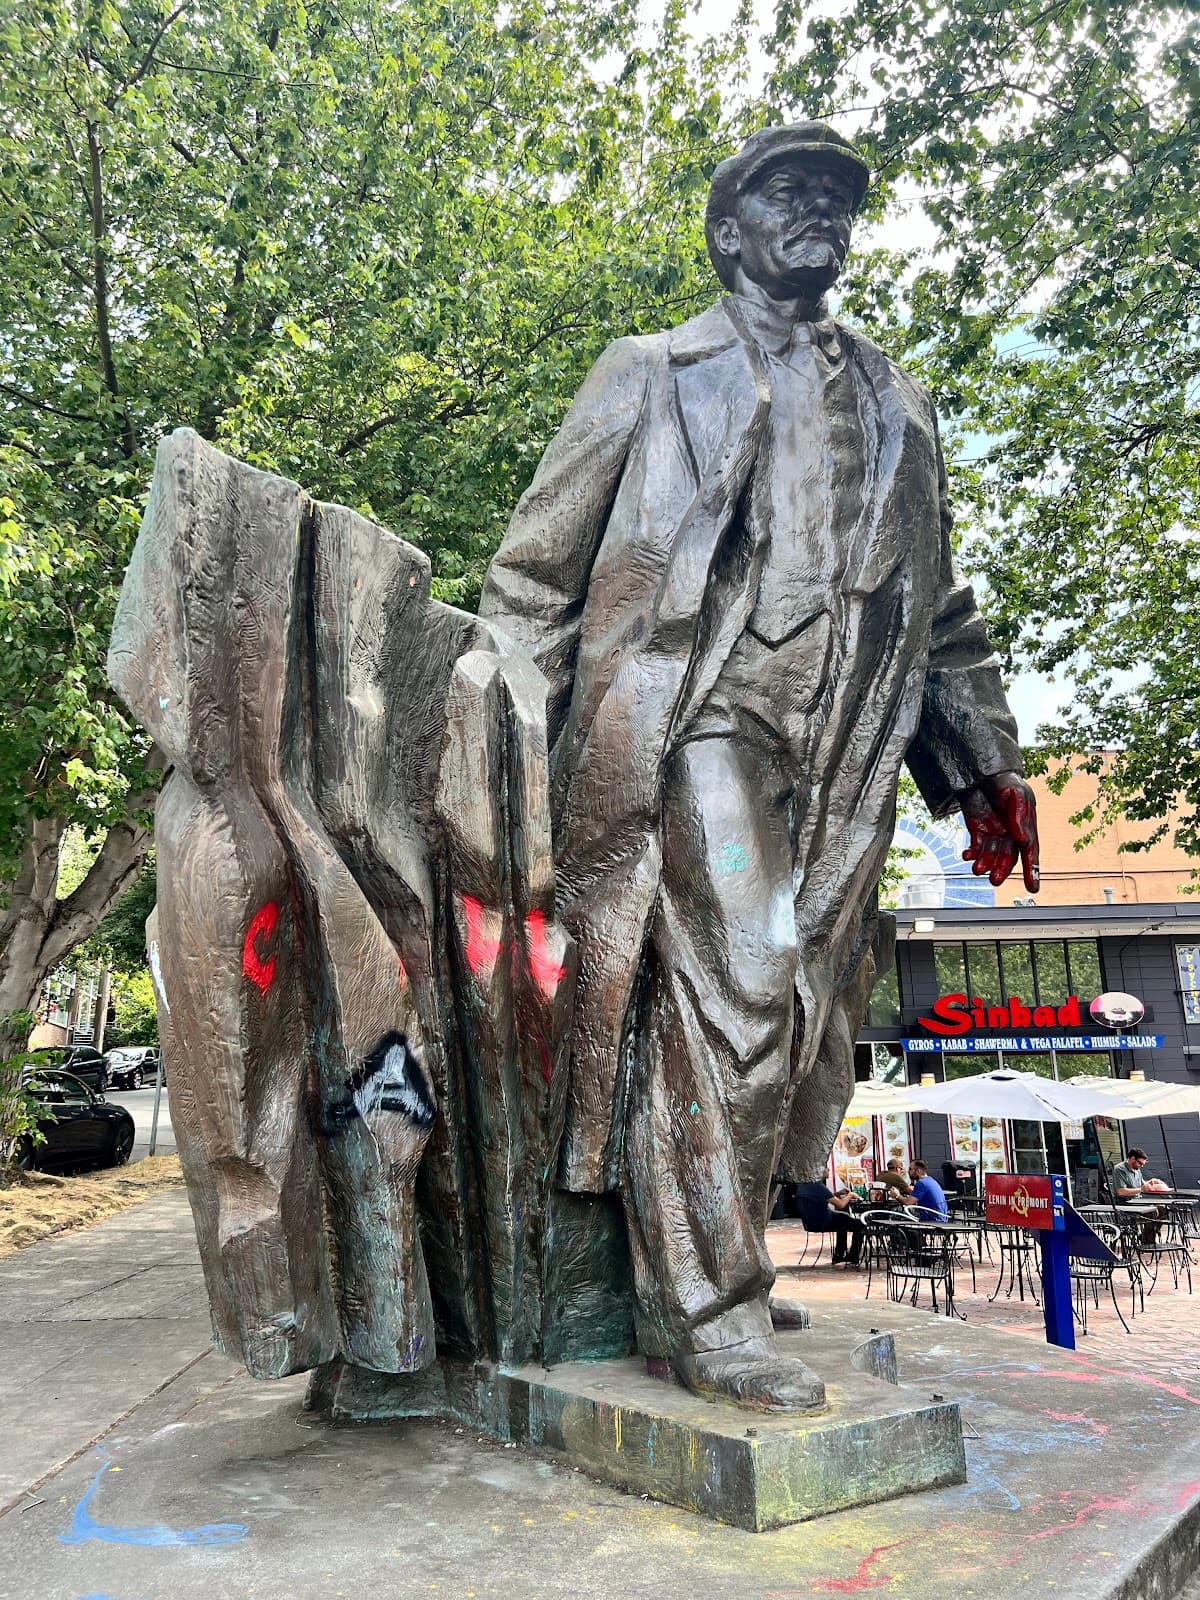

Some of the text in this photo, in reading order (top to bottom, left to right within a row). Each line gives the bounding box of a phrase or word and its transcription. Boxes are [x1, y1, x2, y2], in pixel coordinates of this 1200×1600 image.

[917, 992, 1081, 1036] Sinbad
[908, 1035, 1157, 1051] GYROS KABAB SHAWERMA & VEGA FALAFEL HUMUS SALADS
[988, 1194, 1007, 1206] LENIN
[1009, 1195, 1016, 1206] IN
